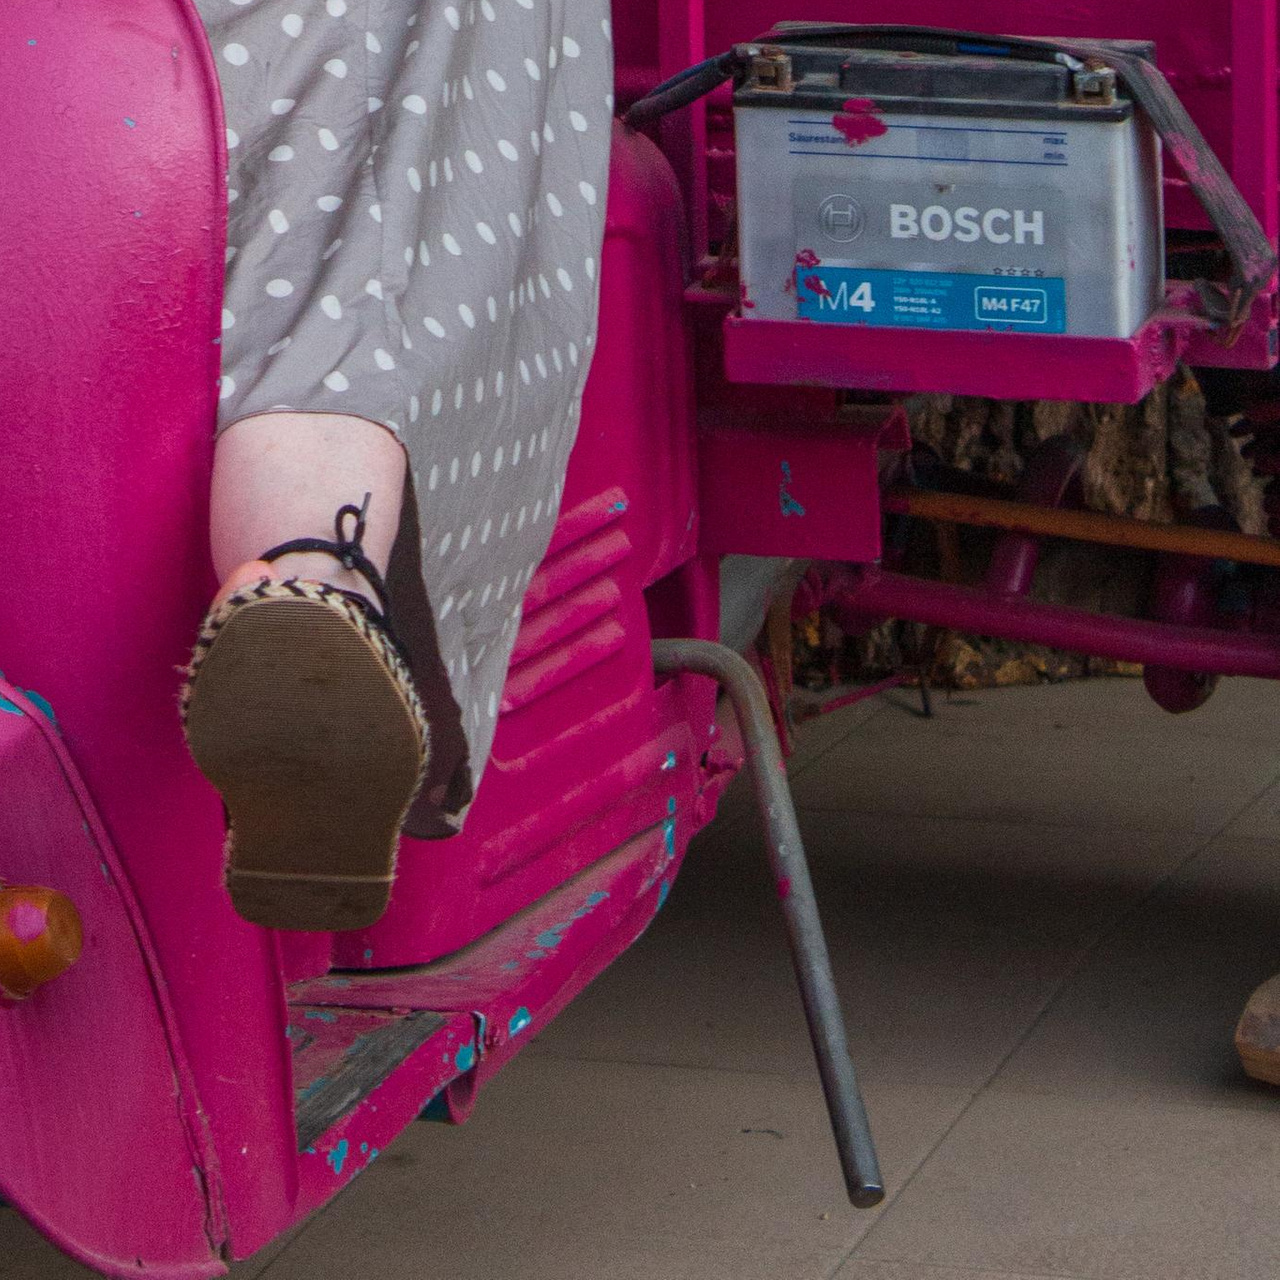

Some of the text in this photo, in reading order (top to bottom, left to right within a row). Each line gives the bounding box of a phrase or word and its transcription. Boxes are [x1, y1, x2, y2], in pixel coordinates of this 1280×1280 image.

[888, 203, 1045, 245] BOSCH
[818, 281, 876, 312] M4
[981, 297, 1041, 313] M4 F47
